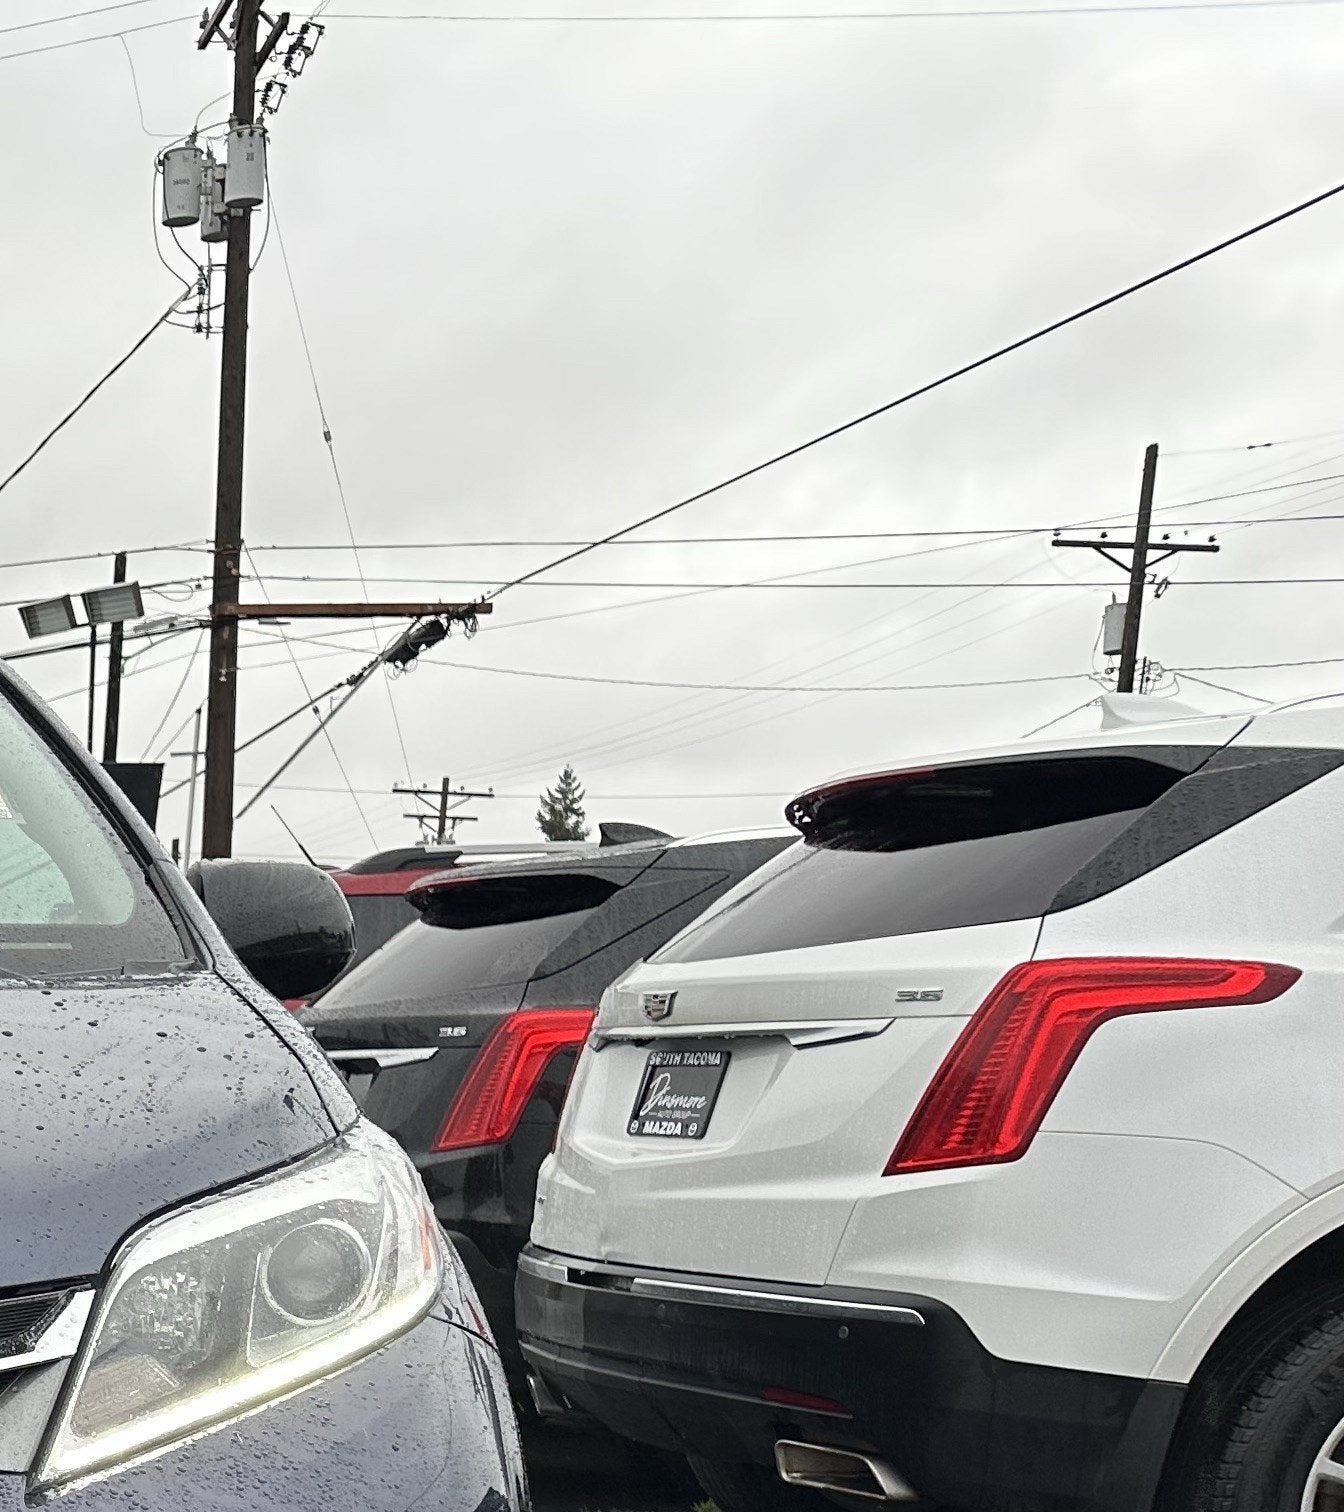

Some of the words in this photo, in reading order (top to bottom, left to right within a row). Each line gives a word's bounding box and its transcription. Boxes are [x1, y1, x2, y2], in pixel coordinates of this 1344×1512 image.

[683, 1051, 721, 1066] TACOMA
[639, 1072, 708, 1117] Dinsmore
[642, 1121, 683, 1136] MAZDA
